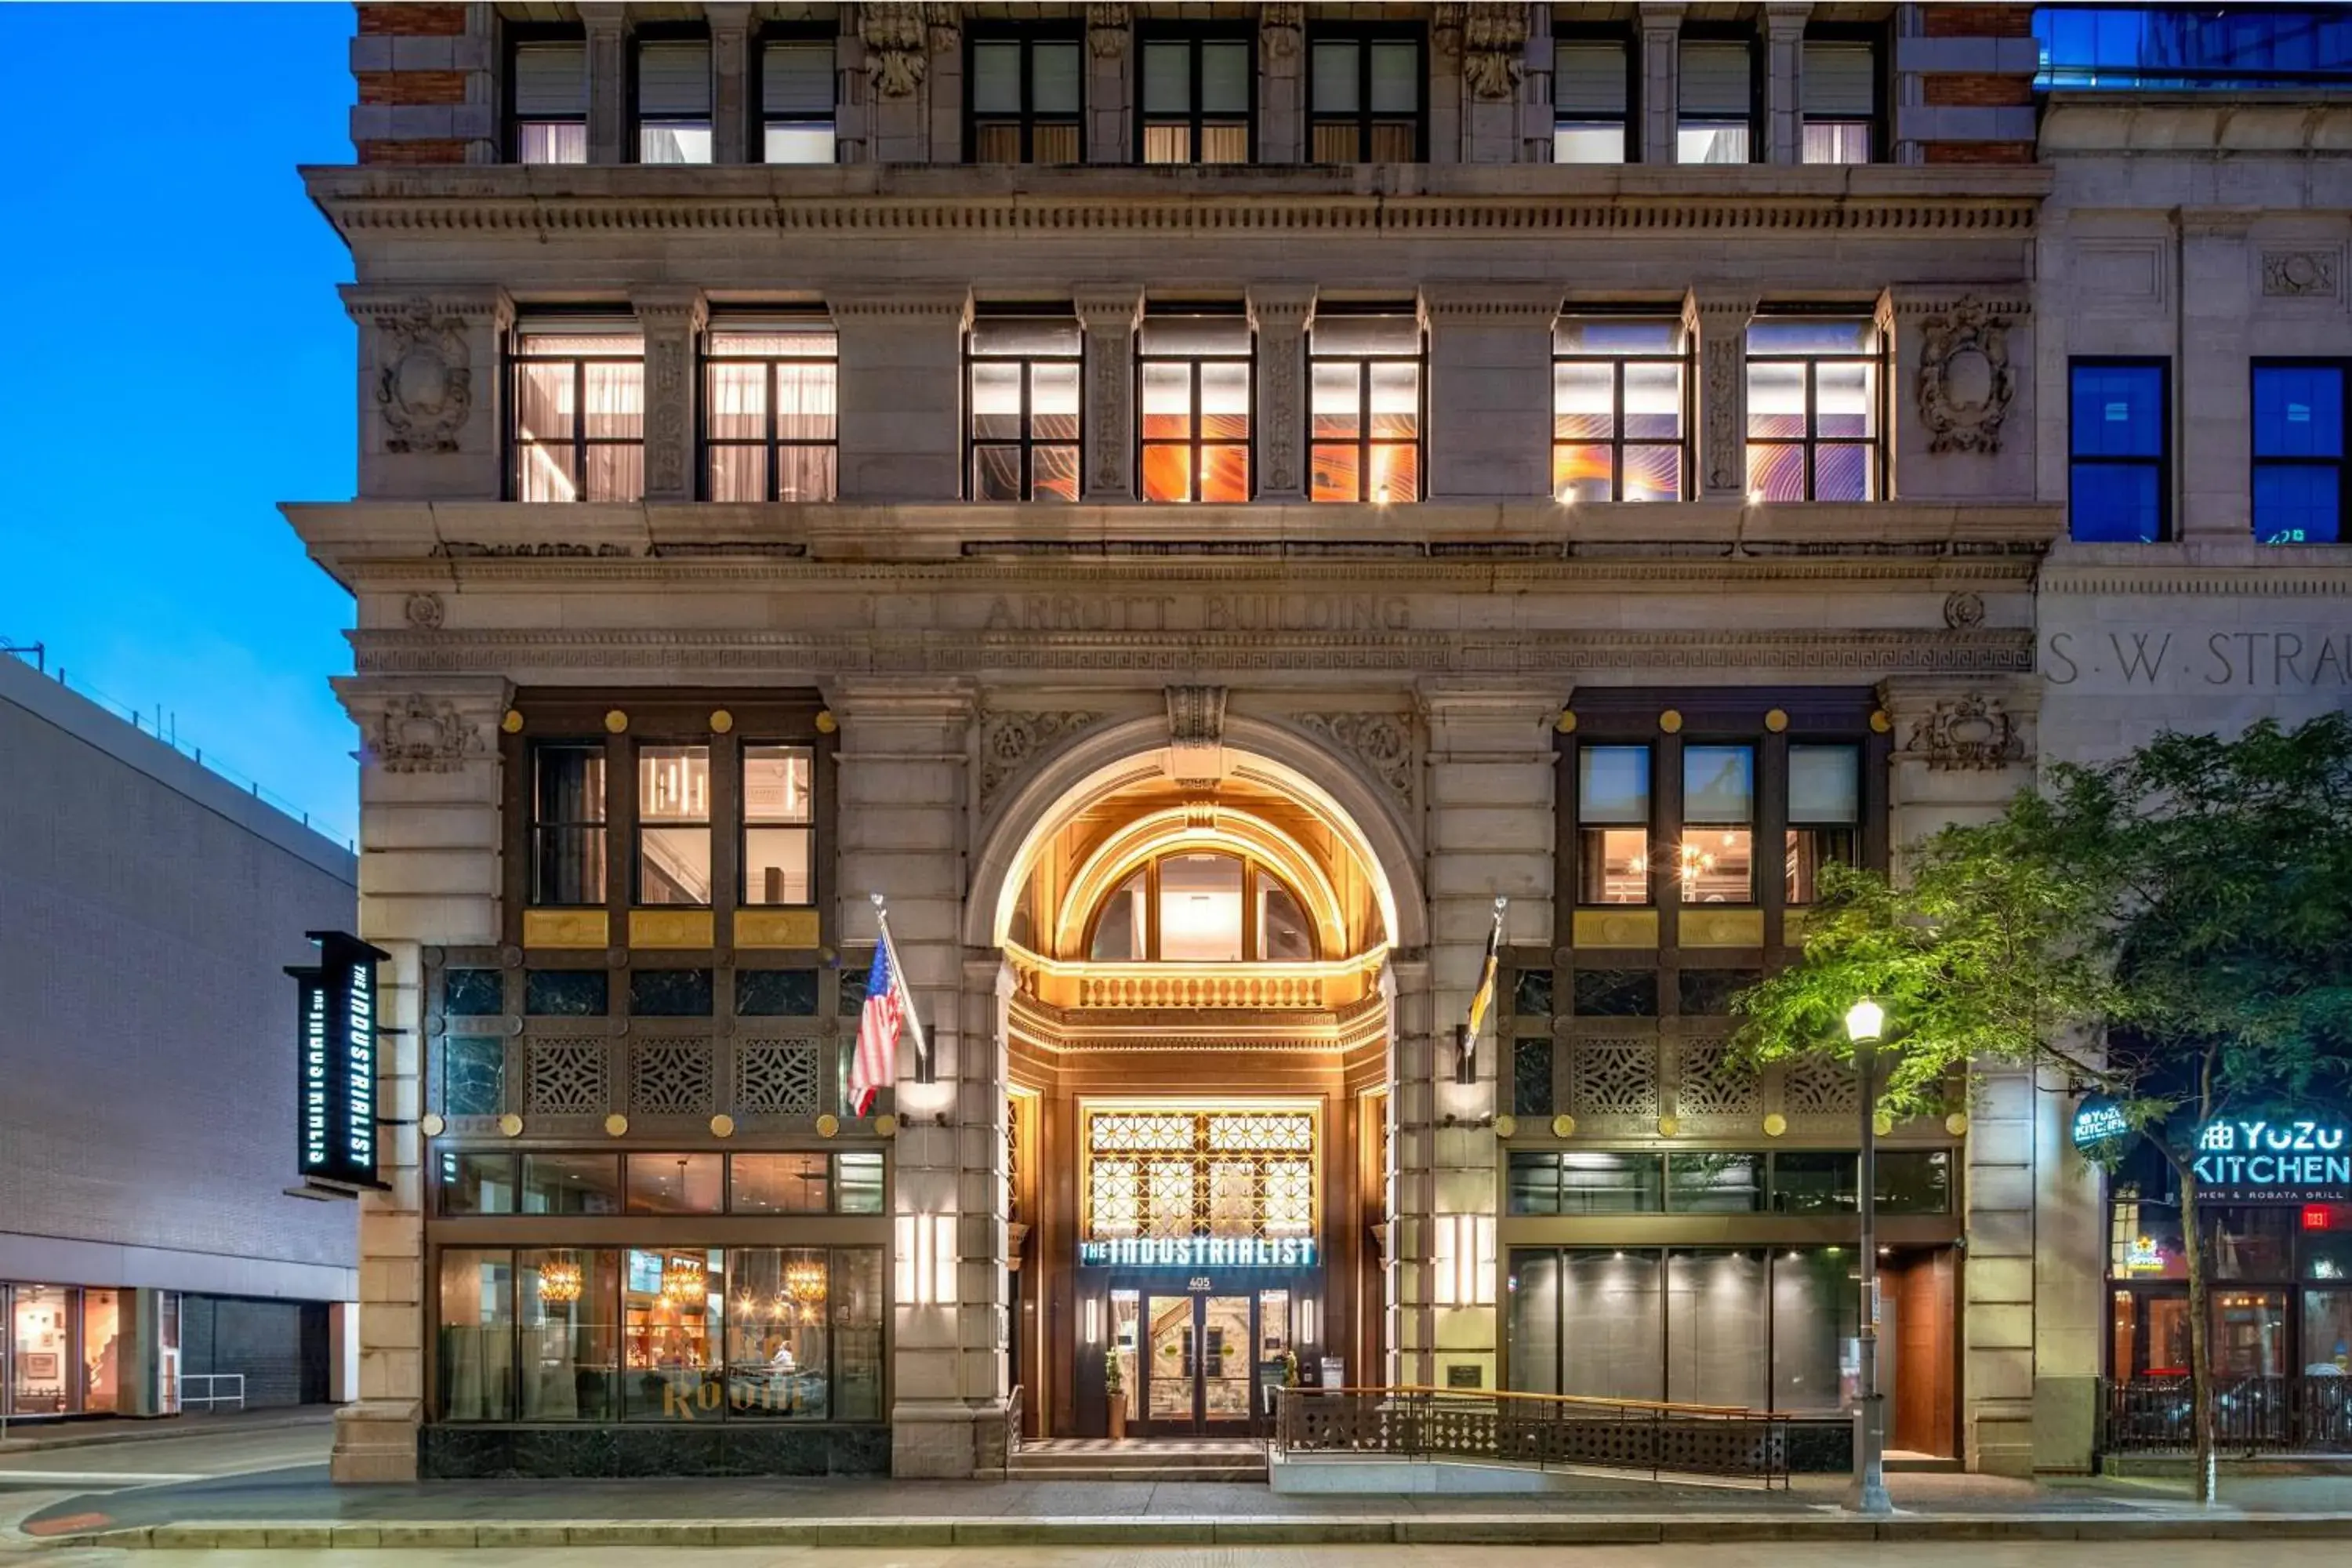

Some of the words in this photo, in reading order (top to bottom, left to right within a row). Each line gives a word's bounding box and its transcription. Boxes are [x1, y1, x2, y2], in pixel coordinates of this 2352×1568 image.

[984, 593, 1177, 630] ARROTT
[1203, 593, 1410, 630] BUILDING
[354, 965, 366, 989] THE
[351, 988, 369, 1166] INDUSTRIALIST
[1081, 1243, 1106, 1258] THE
[1110, 1238, 1315, 1265] INDUSTRIALIST
[1189, 1277, 1210, 1287] 405
